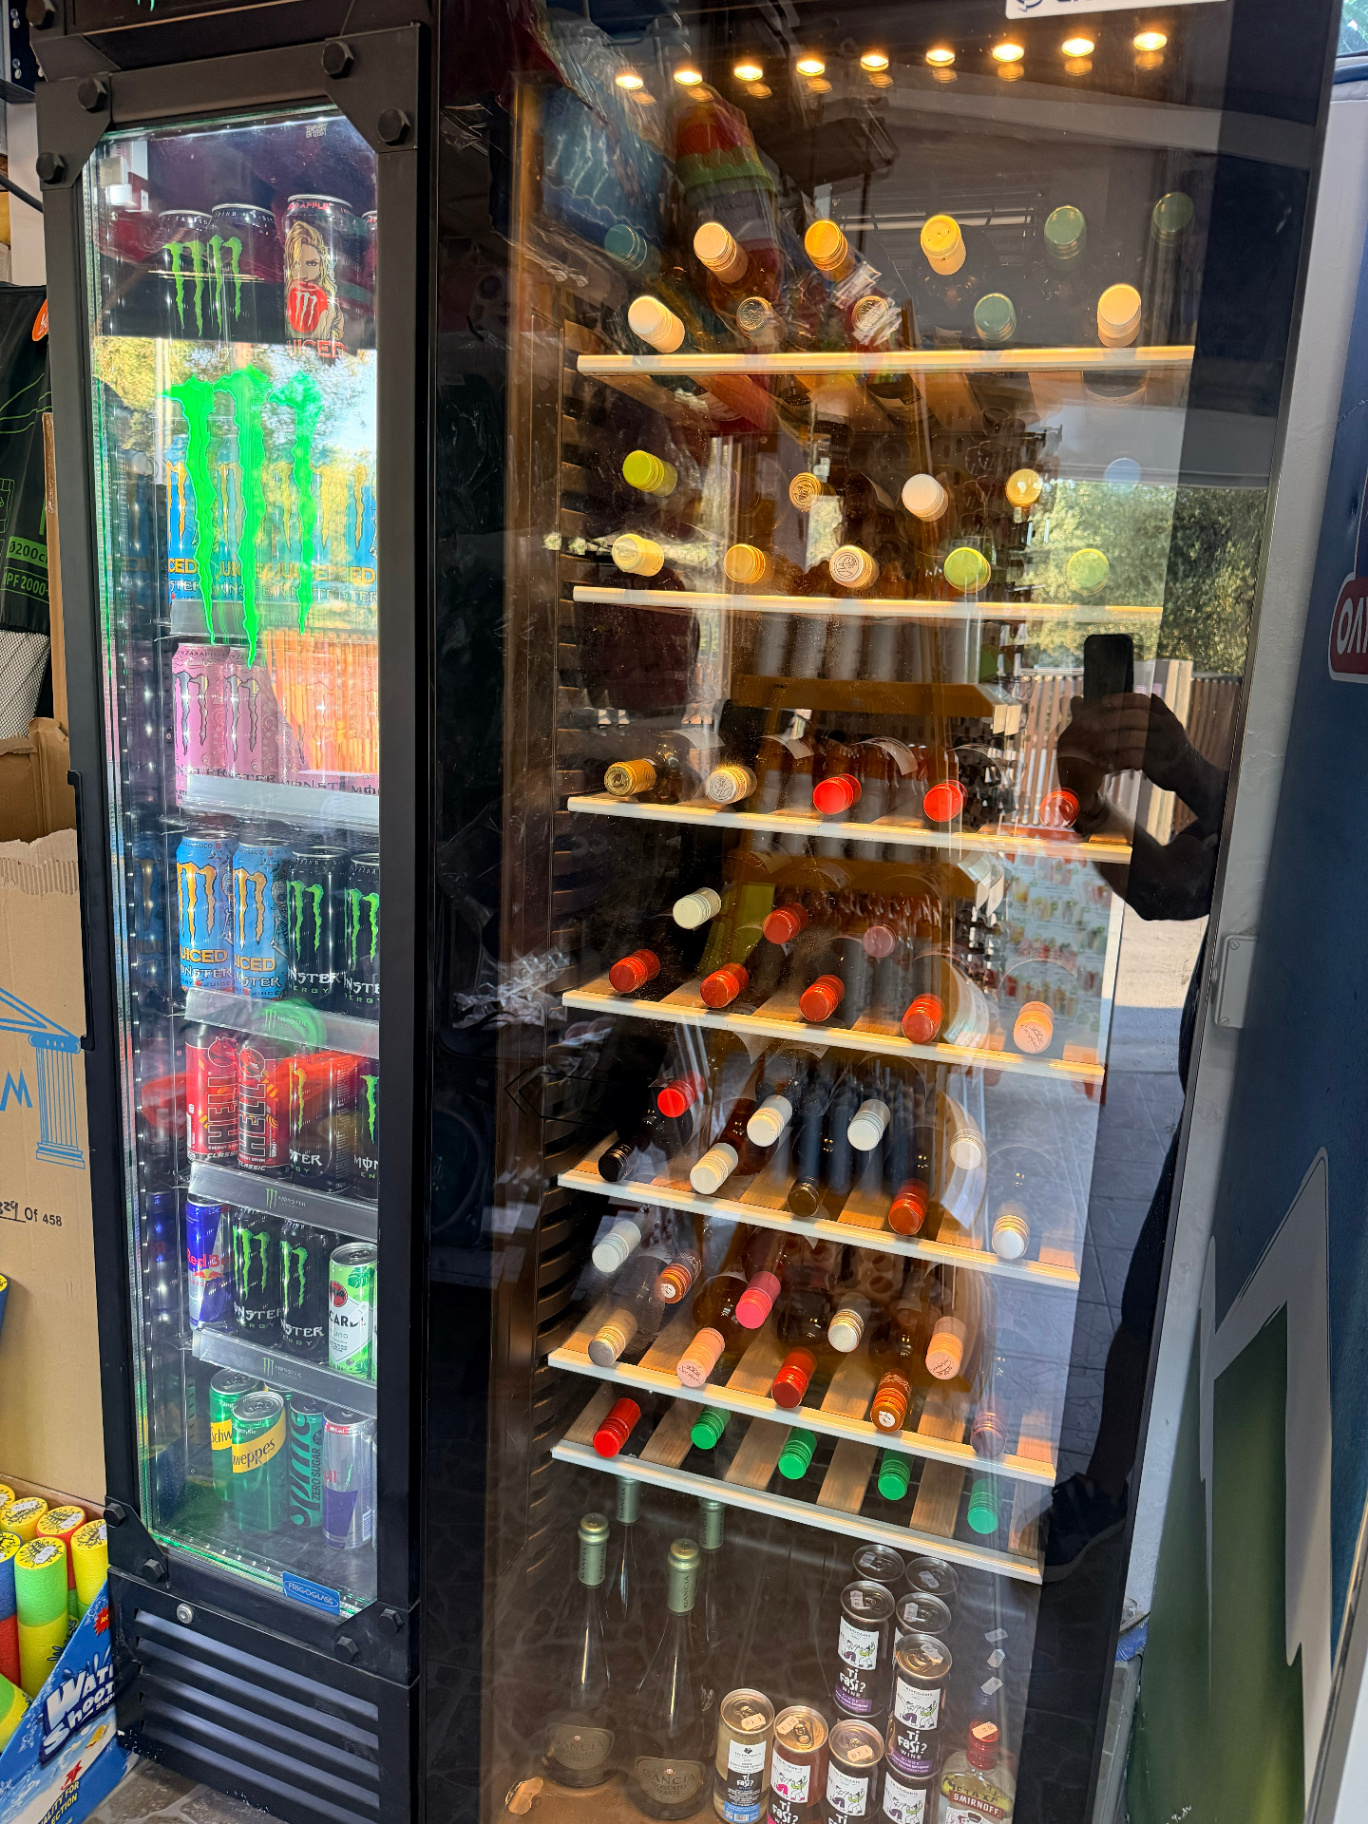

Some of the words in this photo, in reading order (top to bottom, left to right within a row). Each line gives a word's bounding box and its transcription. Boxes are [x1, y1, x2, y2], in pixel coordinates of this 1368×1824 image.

[9, 541, 47, 563] Ø200c
[239, 1083, 266, 1157] HELL
[24, 1207, 38, 1222] Of
[42, 1213, 63, 1227] 458
[311, 1447, 321, 1478] SUGAR
[311, 1477, 321, 1501] ZERO
[288, 1582, 334, 1605] FRIGOGLASS
[65, 1781, 79, 1799] FOR
[779, 1800, 791, 1812] Ti
[953, 1793, 1000, 1815] SMIRNOFF
